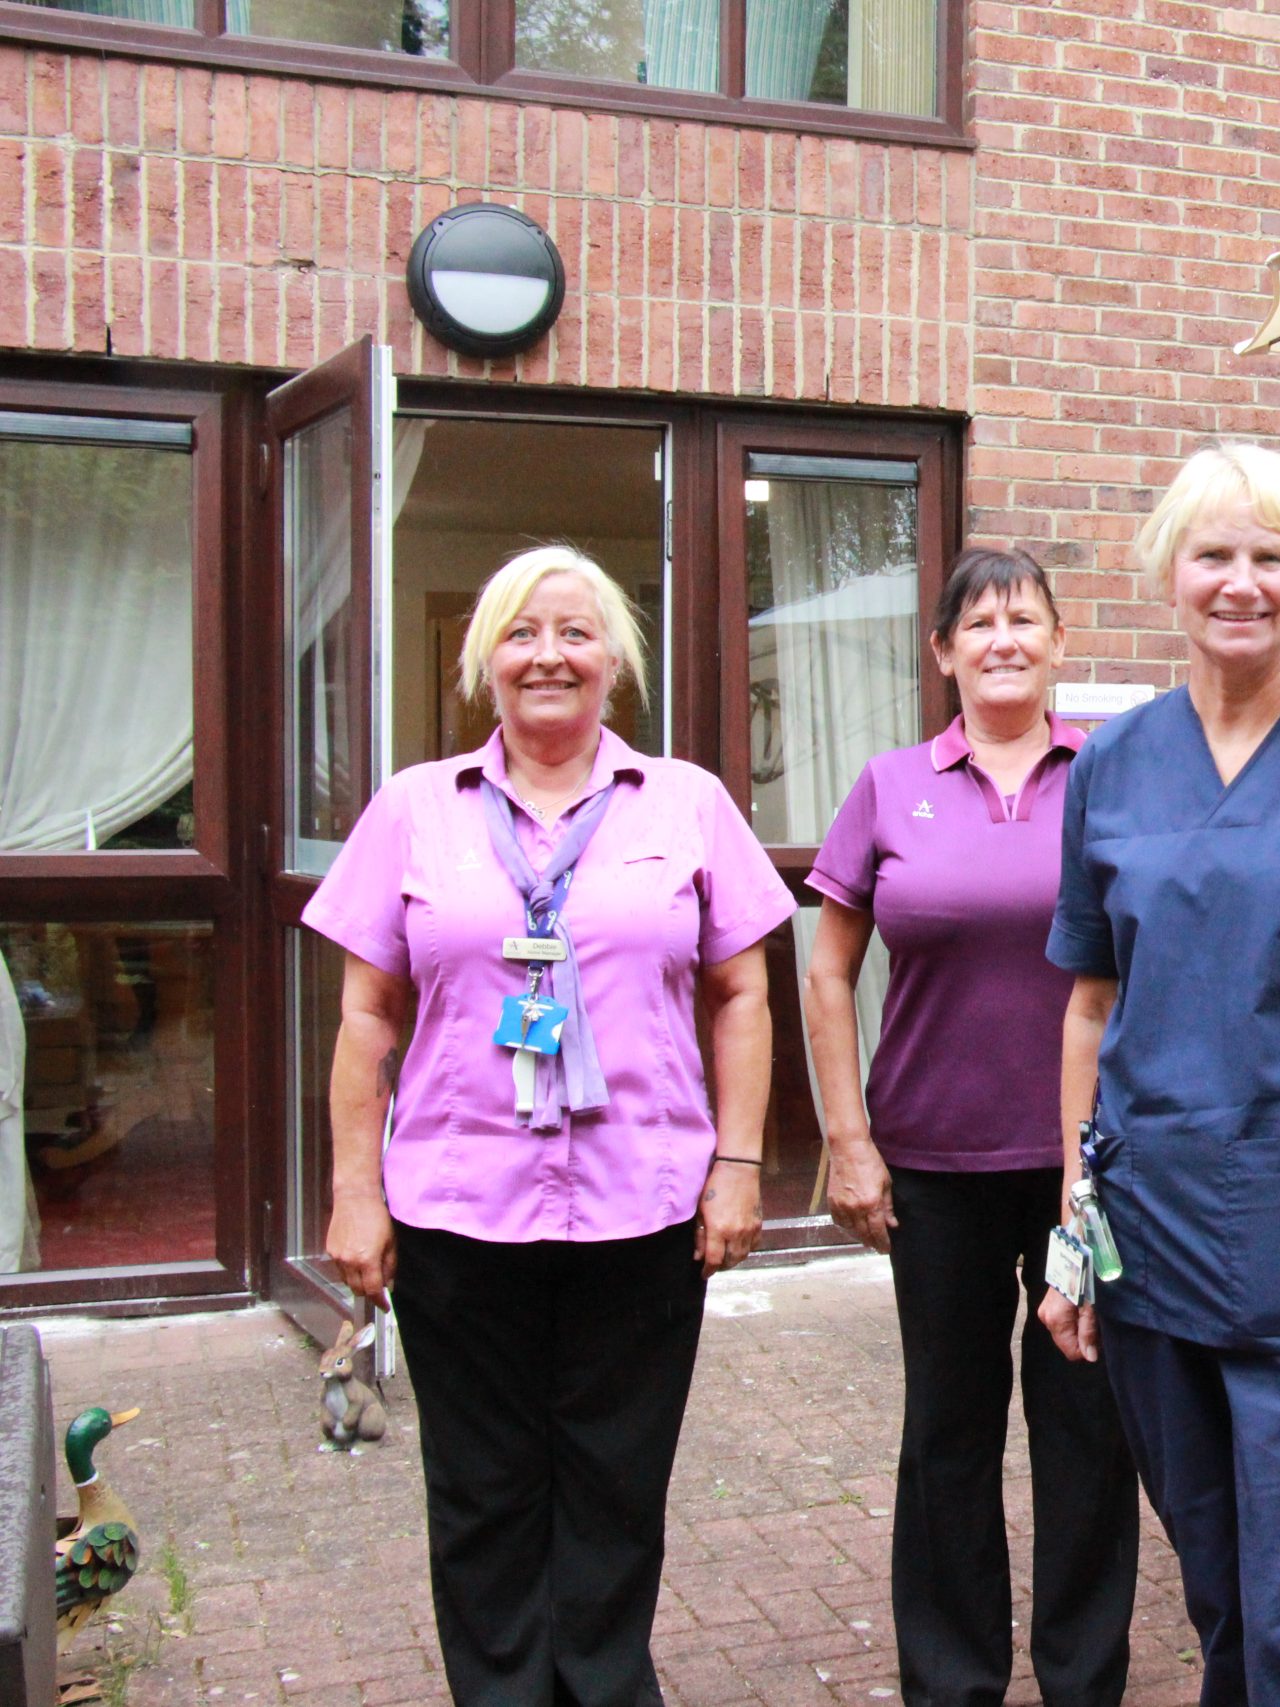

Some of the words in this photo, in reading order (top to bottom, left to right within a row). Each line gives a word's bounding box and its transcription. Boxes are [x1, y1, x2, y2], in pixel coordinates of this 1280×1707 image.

[1065, 693, 1080, 703] No
[1081, 693, 1123, 705] Smoking
[532, 942, 557, 950] Debbie
